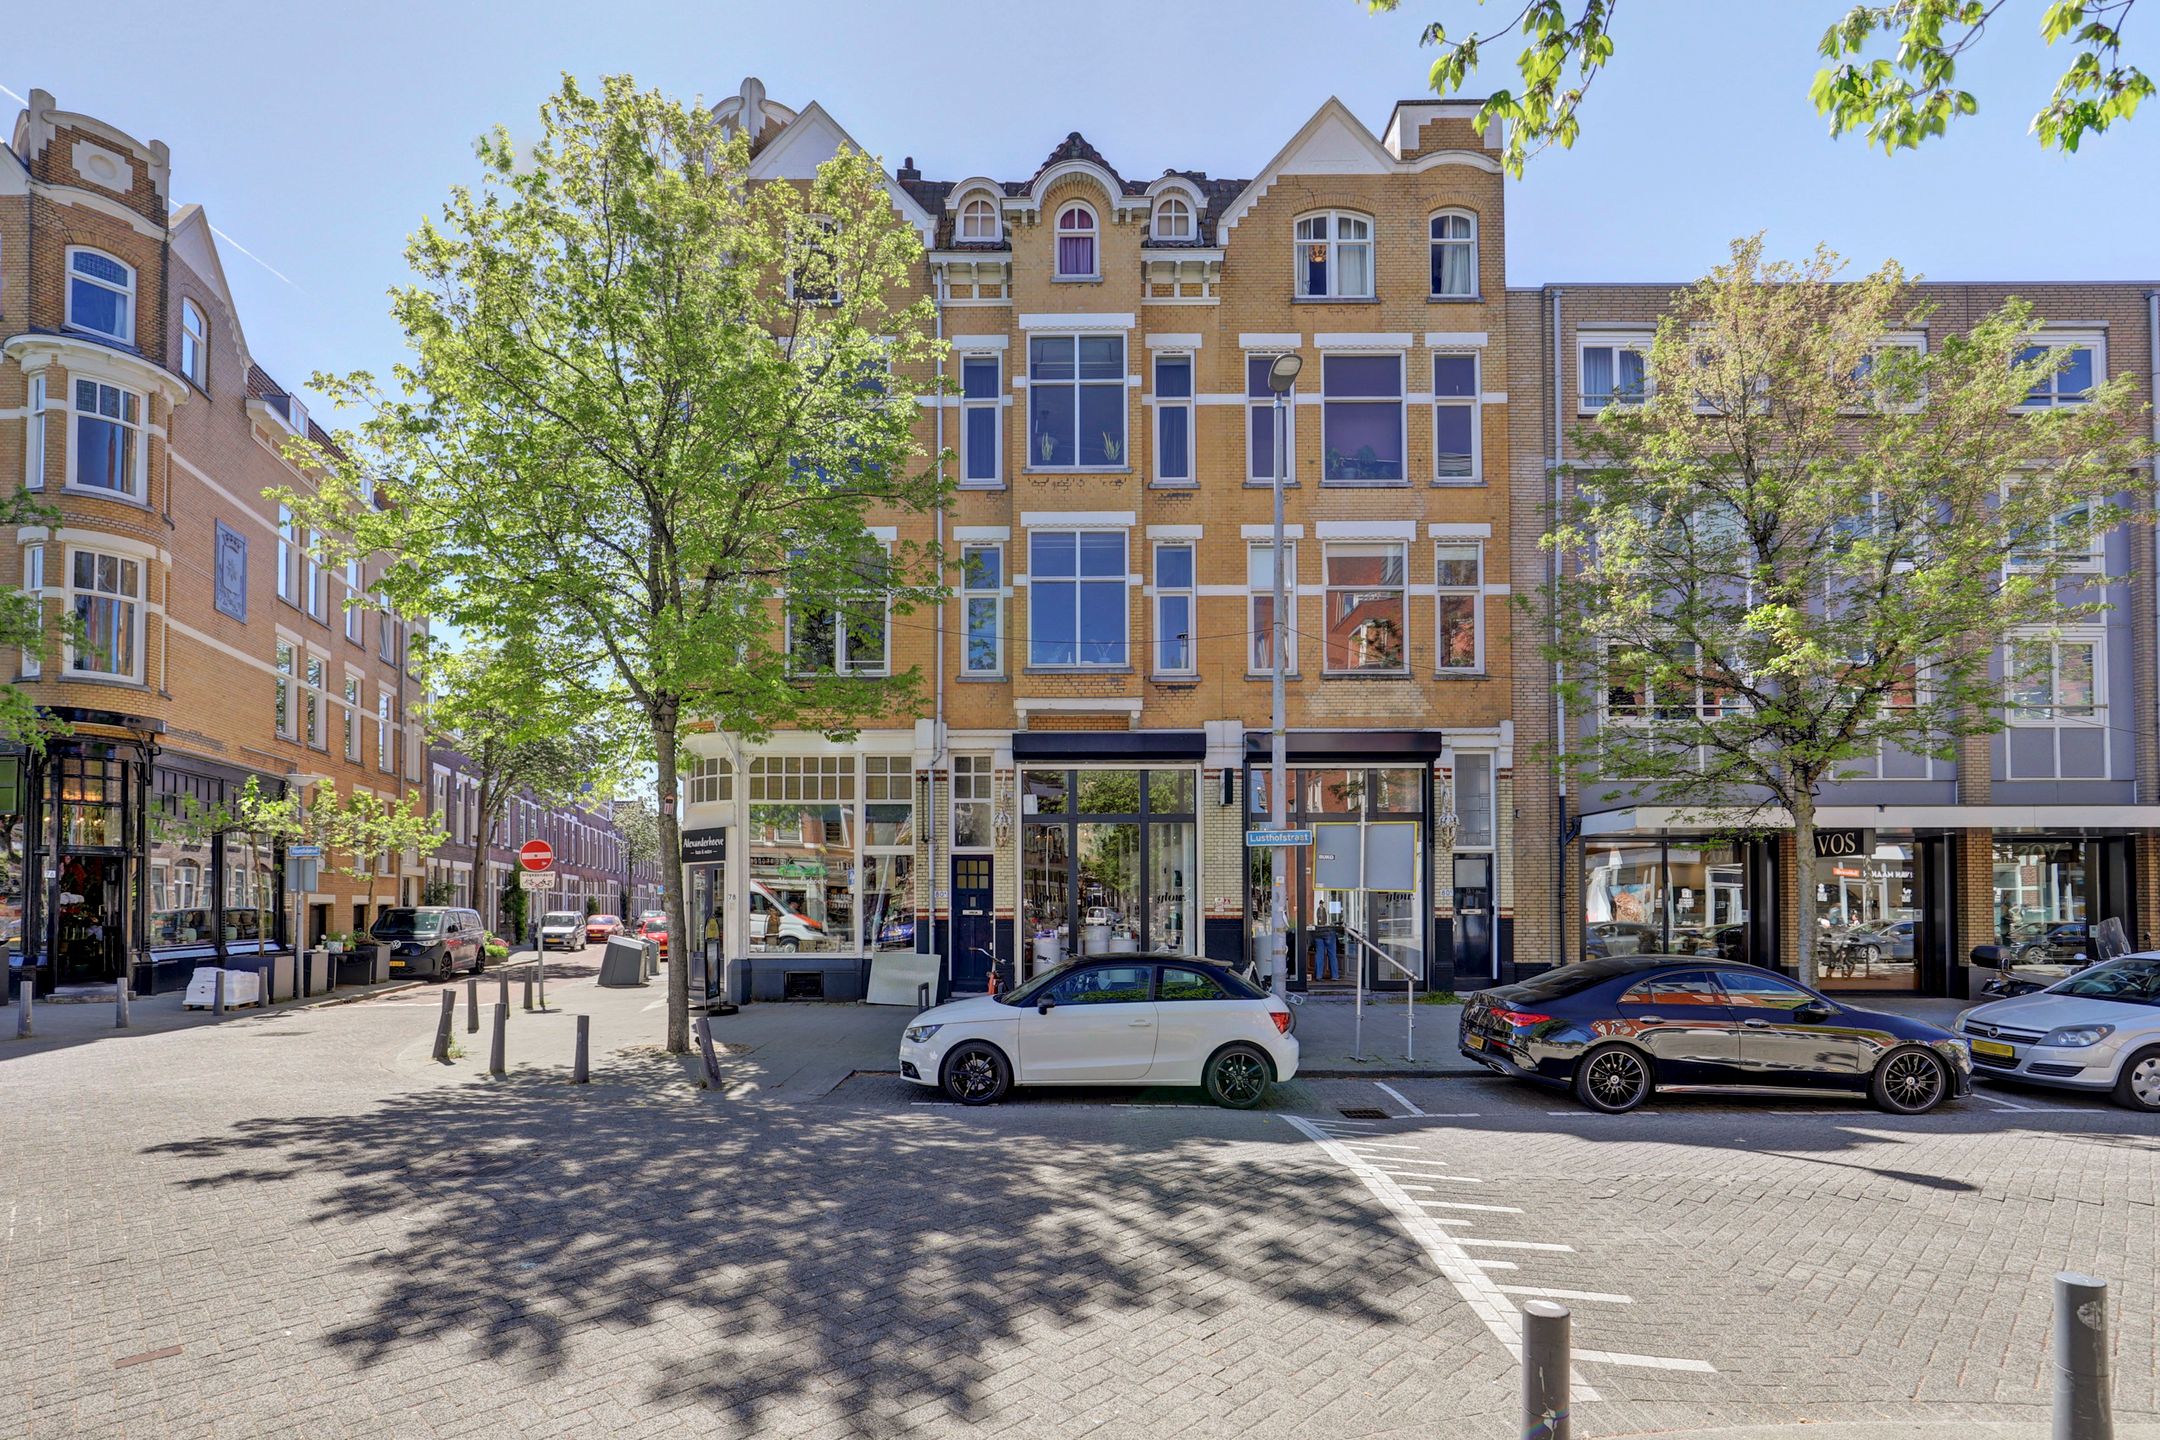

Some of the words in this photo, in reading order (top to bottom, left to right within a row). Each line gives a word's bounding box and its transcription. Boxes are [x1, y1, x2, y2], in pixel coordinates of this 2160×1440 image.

[683, 835, 724, 848] Alexanderhoeve
[1249, 833, 1309, 842] Lusthofstraat
[1816, 831, 1856, 855] VOS
